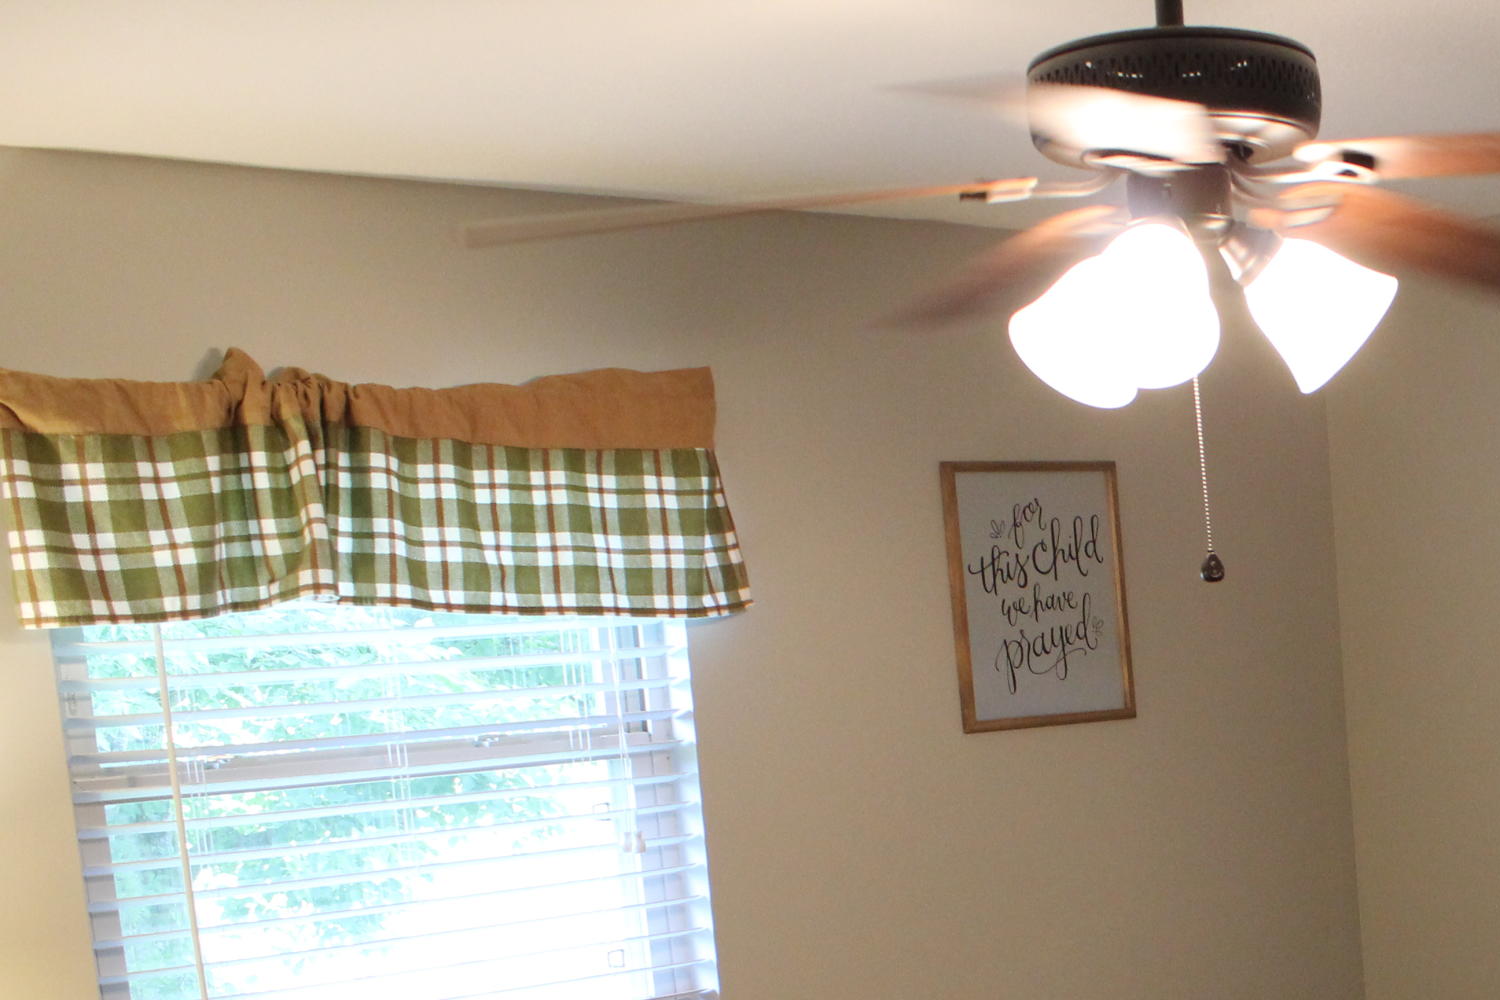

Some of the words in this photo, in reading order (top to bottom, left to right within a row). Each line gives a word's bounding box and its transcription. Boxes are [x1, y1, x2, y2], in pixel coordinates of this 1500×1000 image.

[1008, 497, 1046, 549] for
[968, 545, 1029, 596] this
[1001, 596, 1029, 627] we
[1032, 583, 1077, 622] have
[995, 593, 1098, 695] prayed
